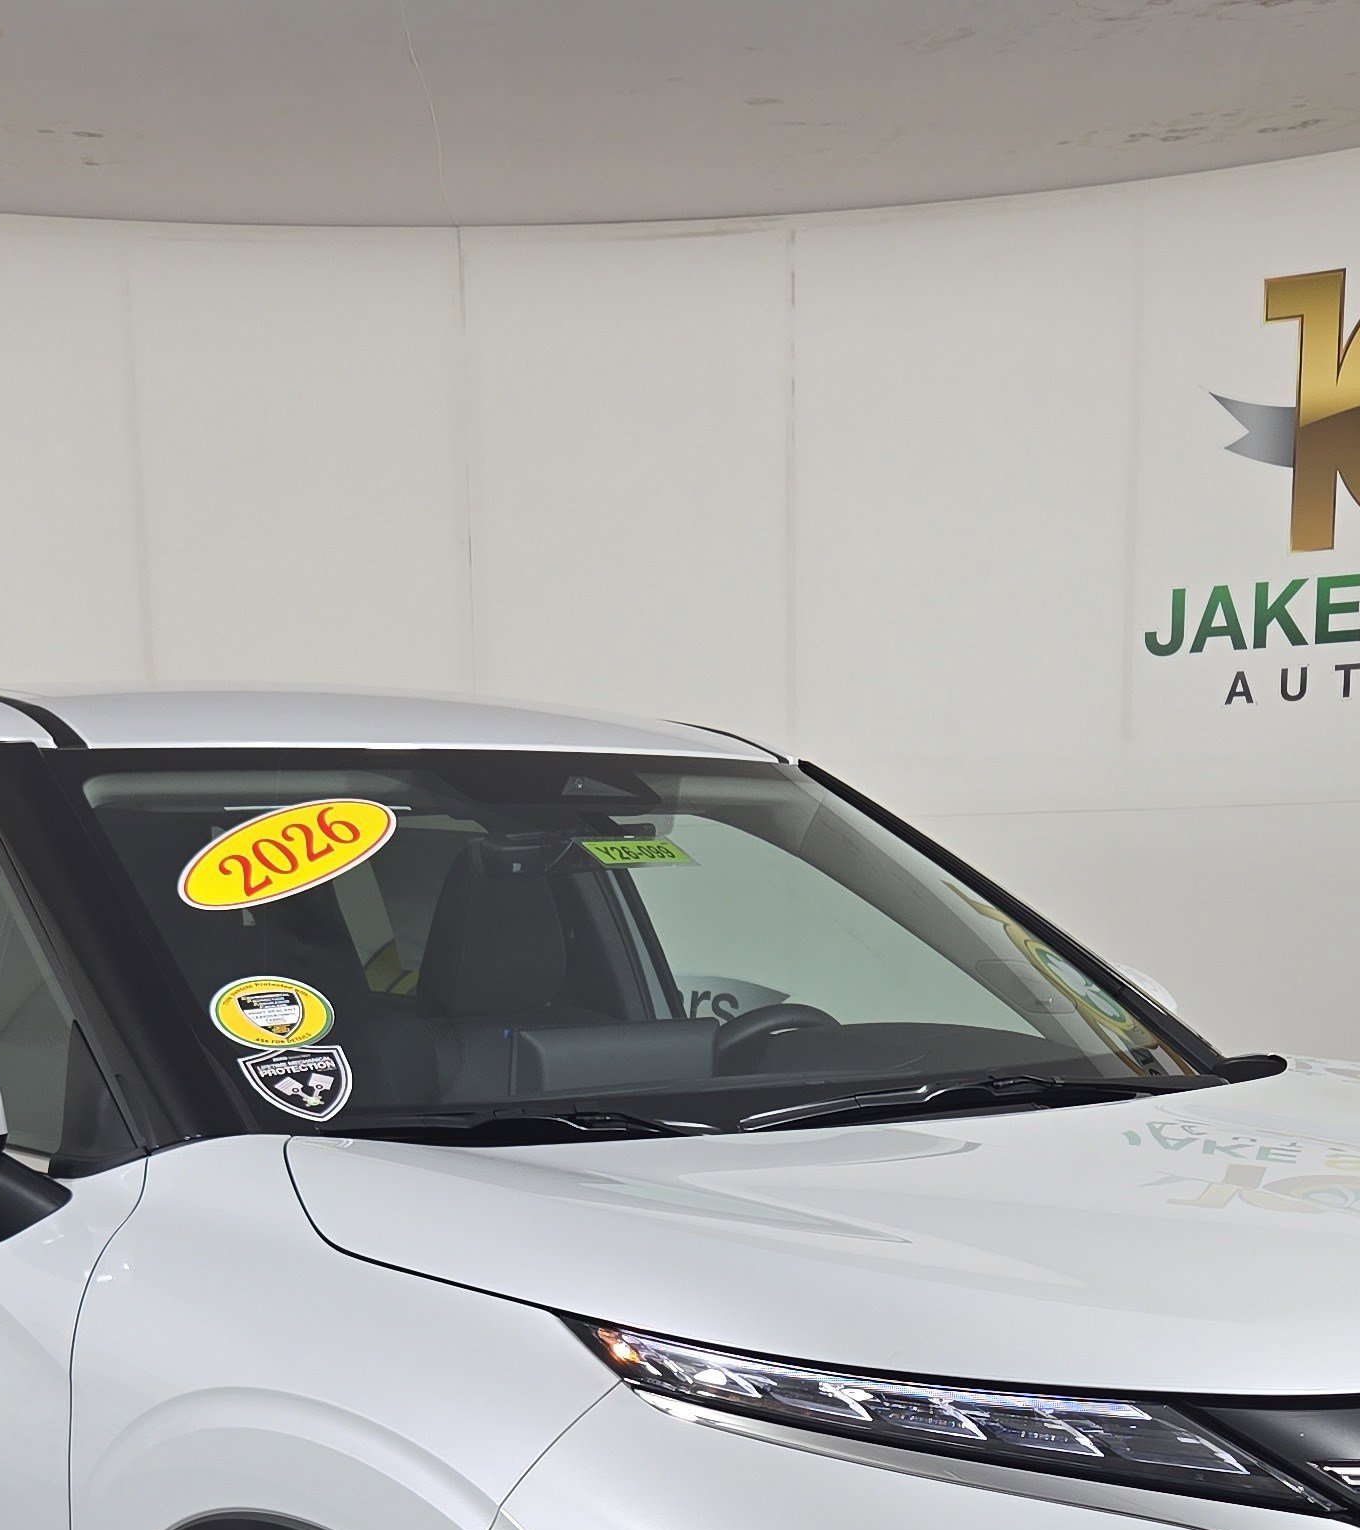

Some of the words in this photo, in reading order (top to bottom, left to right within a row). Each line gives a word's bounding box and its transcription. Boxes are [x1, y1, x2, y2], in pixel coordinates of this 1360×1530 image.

[218, 807, 362, 896] 2026
[595, 845, 676, 861] Y26-099
[260, 1060, 336, 1078] PROTECTION
